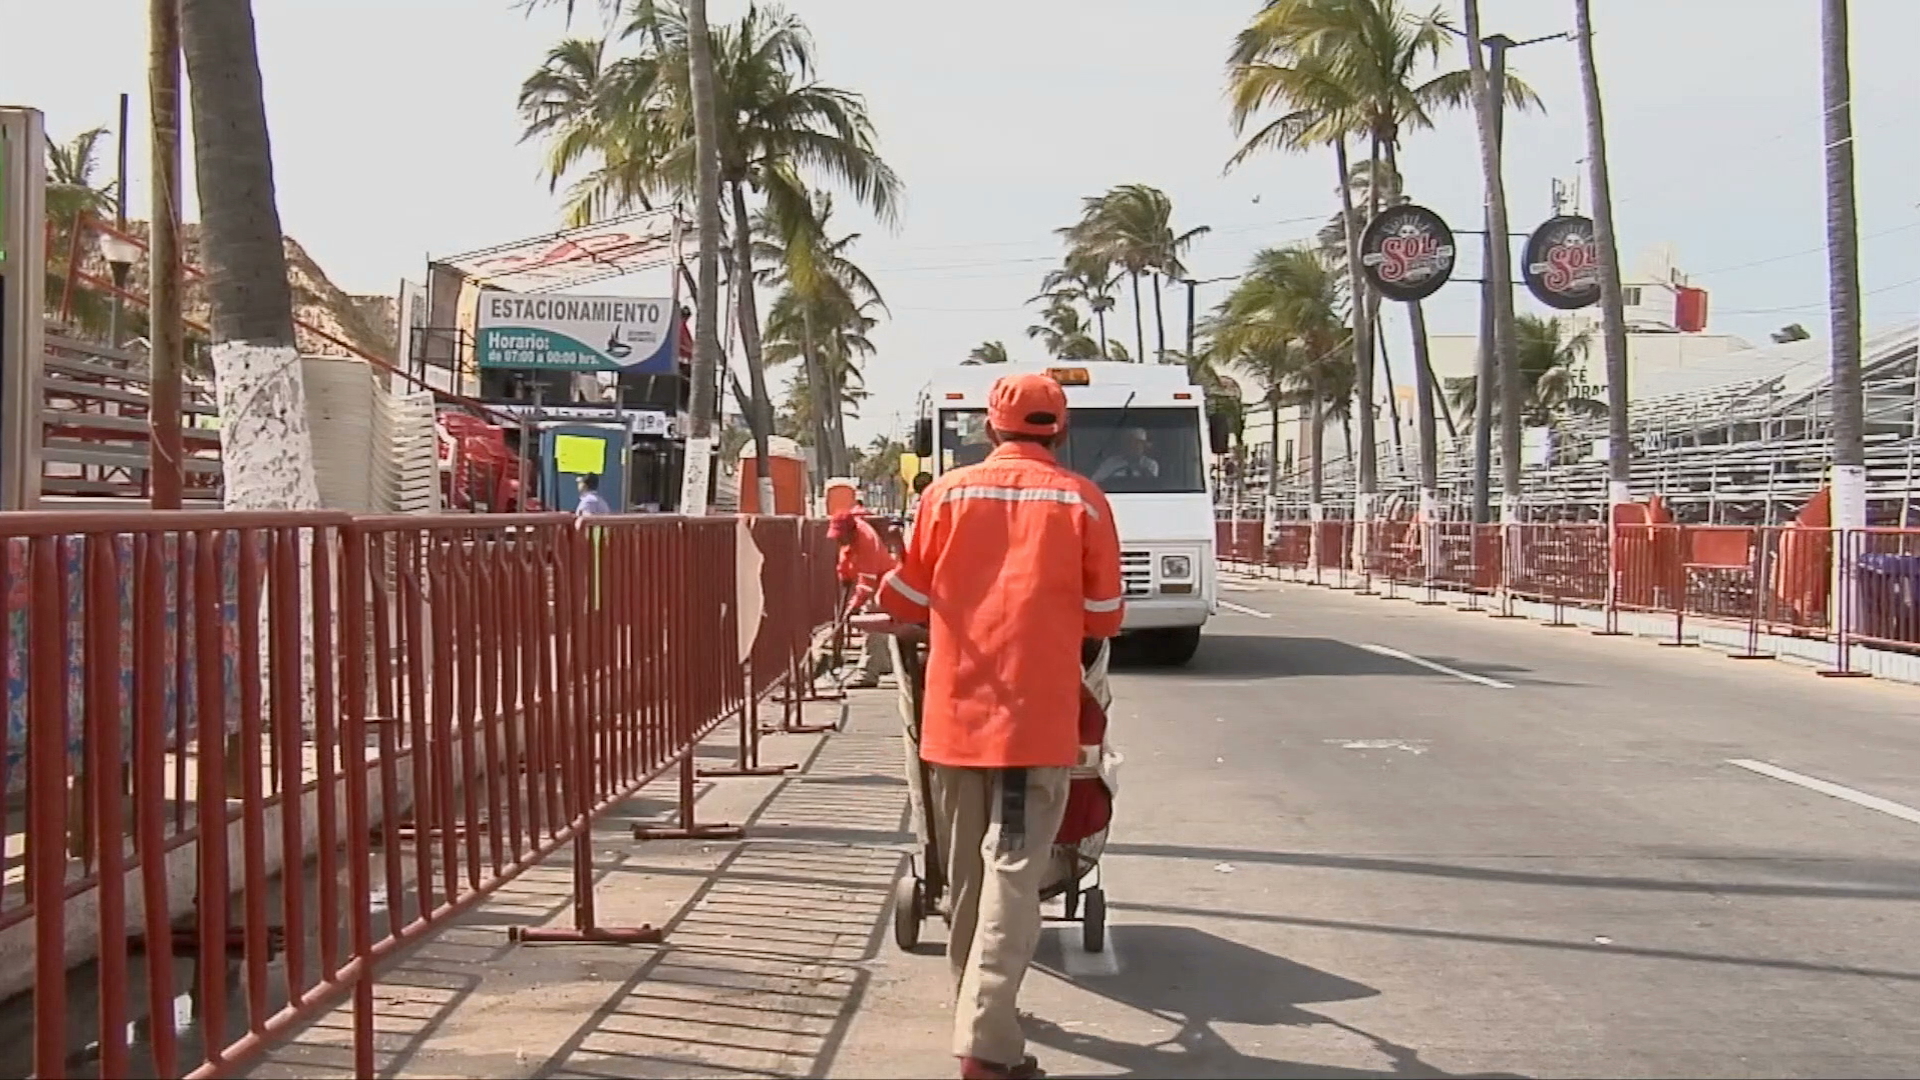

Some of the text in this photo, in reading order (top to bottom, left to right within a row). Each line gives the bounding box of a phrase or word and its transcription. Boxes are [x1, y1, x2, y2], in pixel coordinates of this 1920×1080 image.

[491, 299, 660, 323] ESTACIONAMIENTO
[488, 331, 550, 350] Horario:
[488, 351, 600, 365] de 07:00 a 00:00 hrs.
